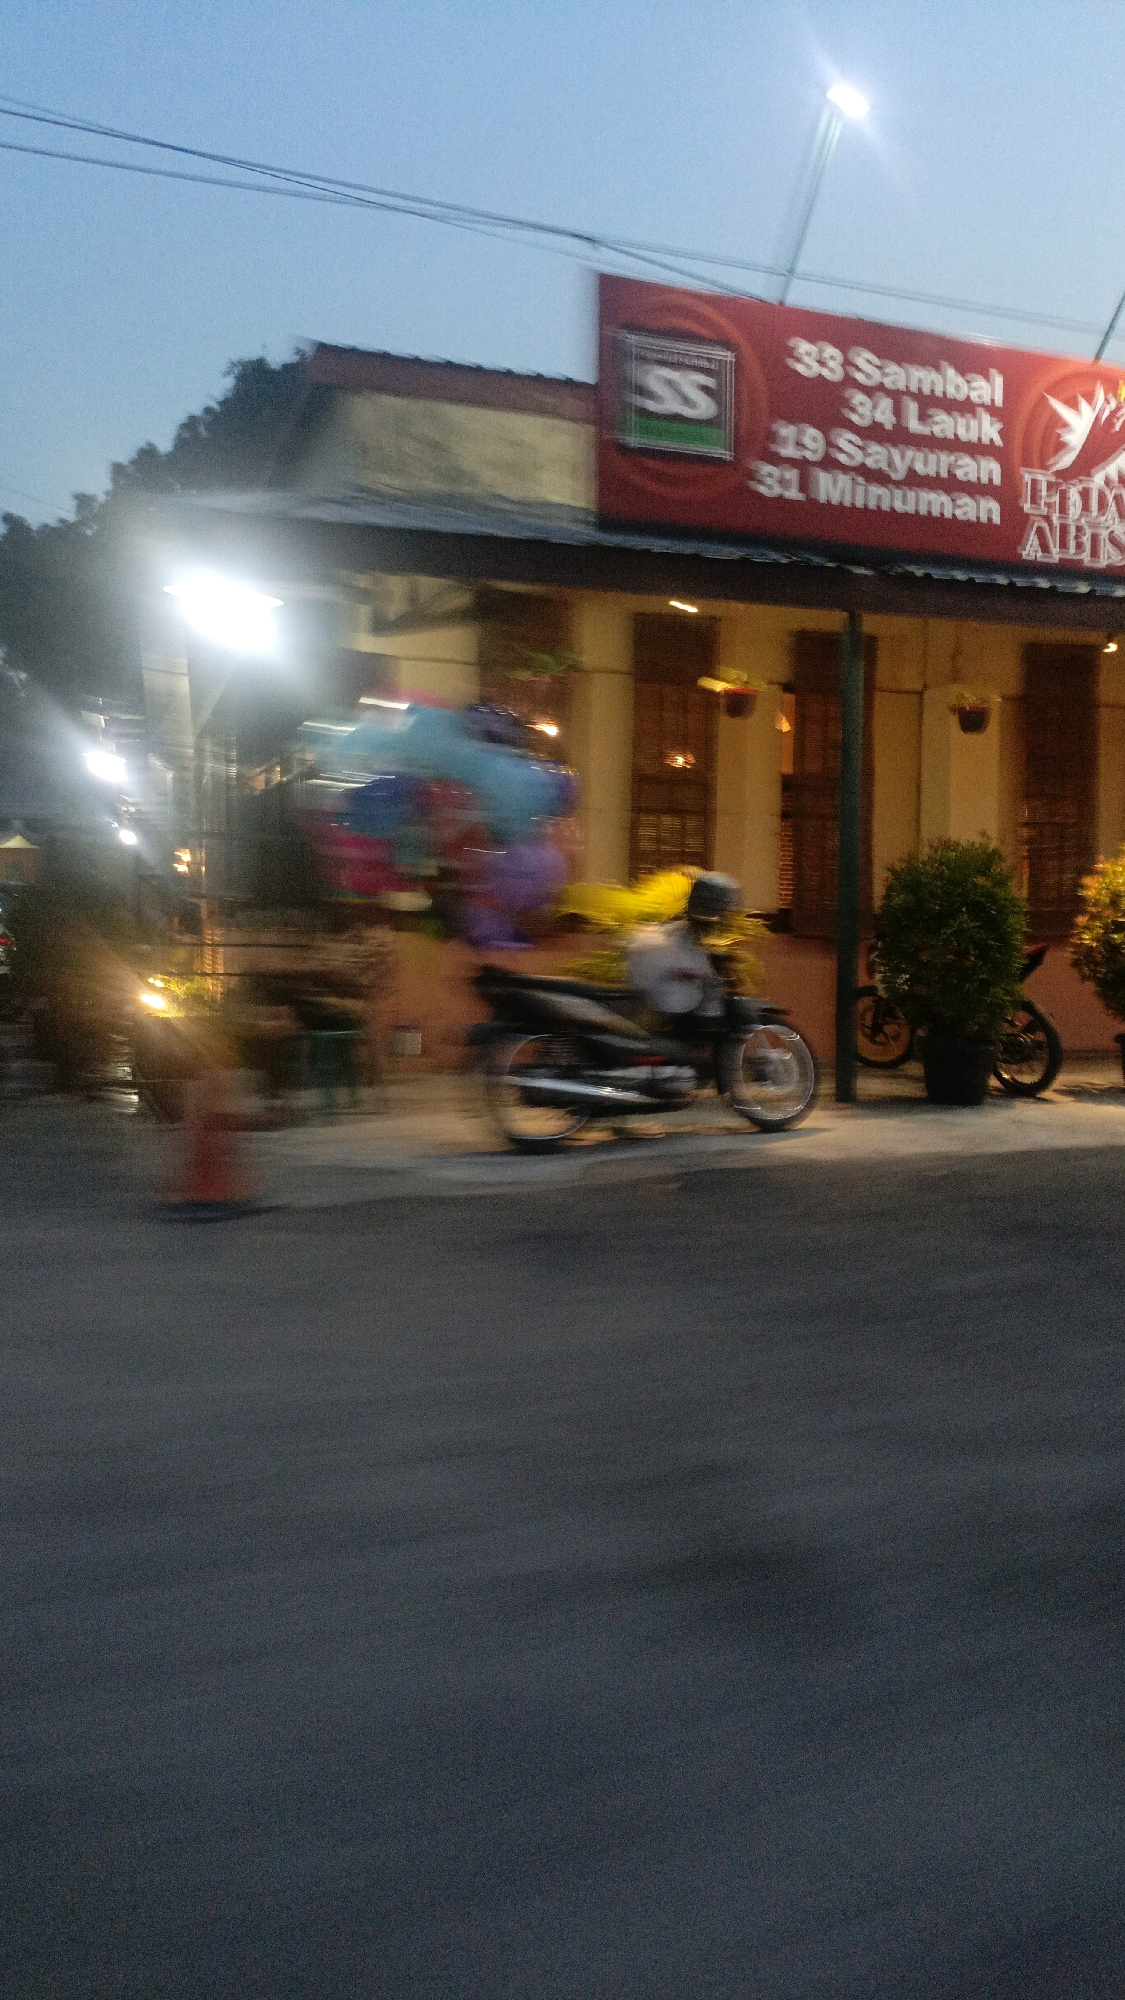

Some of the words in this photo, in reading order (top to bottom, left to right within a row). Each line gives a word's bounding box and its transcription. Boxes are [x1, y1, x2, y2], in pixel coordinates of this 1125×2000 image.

[630, 365, 718, 421] SS
[786, 337, 844, 383] 33
[848, 347, 1004, 408] Sambal
[842, 388, 895, 430] 34
[902, 395, 1004, 447] Lauk
[772, 420, 826, 462] 19
[829, 426, 1002, 485] Sayuran
[751, 460, 806, 501] 31
[812, 467, 1001, 524] Minuman
